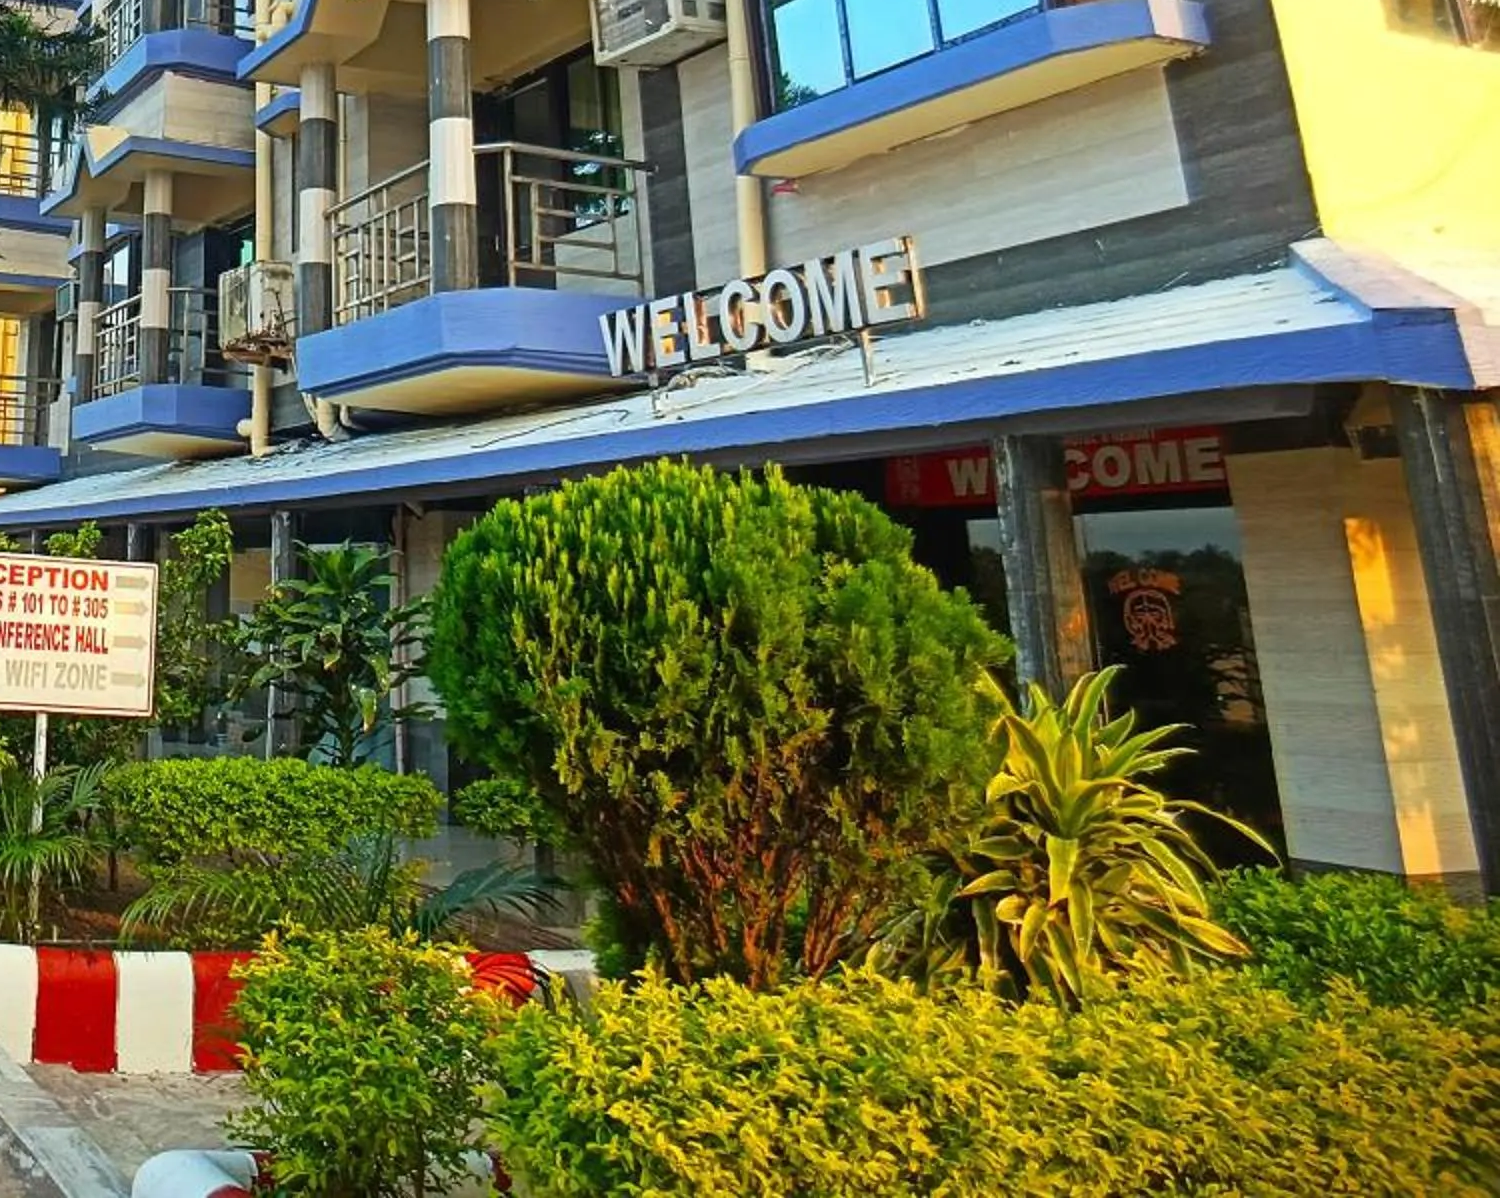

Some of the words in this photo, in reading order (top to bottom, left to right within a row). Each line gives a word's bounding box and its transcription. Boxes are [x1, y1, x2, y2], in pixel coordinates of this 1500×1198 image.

[597, 235, 928, 378] WELCOME
[946, 436, 1227, 497] WCOME
[21, 593, 44, 615] 101
[49, 594, 69, 617] TO
[74, 625, 109, 655] HALL
[4, 659, 49, 689] WIFI
[54, 663, 108, 691] ZONE
